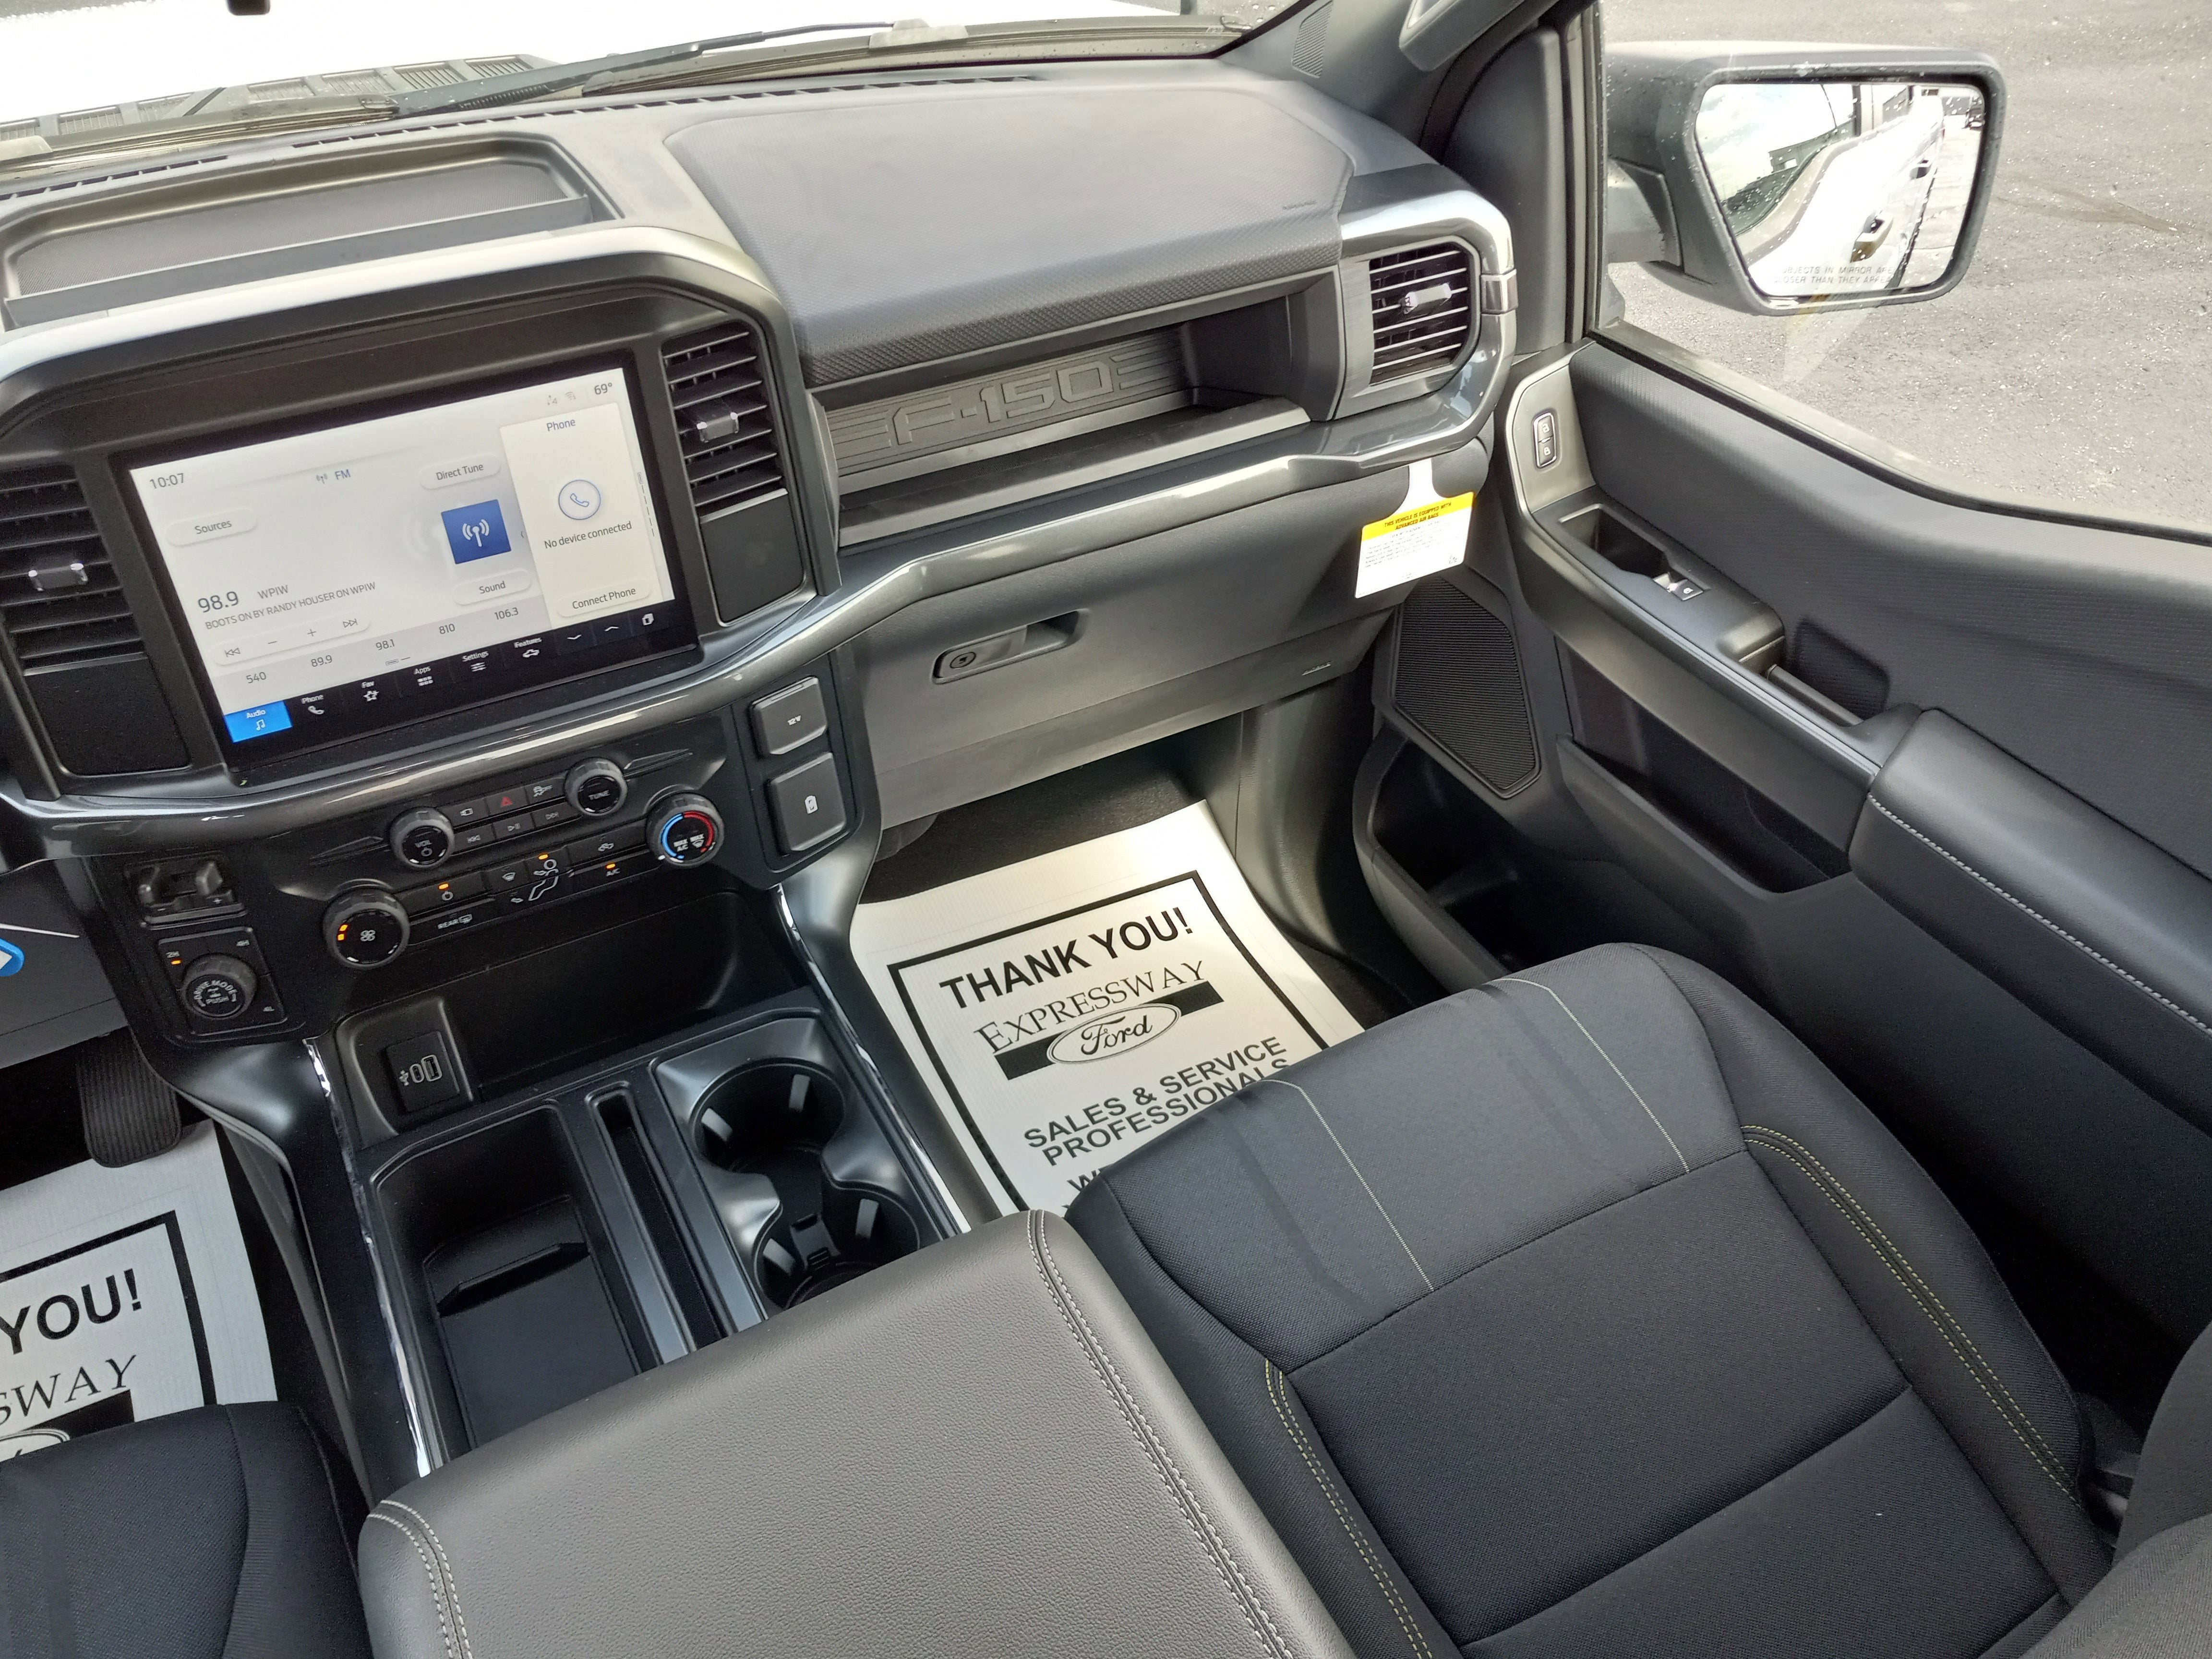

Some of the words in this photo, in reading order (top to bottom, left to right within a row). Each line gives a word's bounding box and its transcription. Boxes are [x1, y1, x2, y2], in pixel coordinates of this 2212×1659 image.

[594, 383, 613, 395] 69°
[892, 360, 1114, 445] F-150
[546, 418, 576, 432] Phone
[334, 469, 351, 480] FM
[435, 468, 461, 481] Direct
[462, 463, 484, 475] Tune
[149, 472, 185, 490] 10:07
[1395, 515, 1412, 524] VEHICLE
[1419, 506, 1439, 517] EQUIPPED
[194, 519, 232, 535] Sources
[1395, 519, 1418, 530] ADVANCED
[544, 538, 558, 549] No
[558, 531, 587, 545] device
[587, 521, 632, 540] connected
[257, 584, 289, 600] WPIW
[479, 581, 506, 594] Sound
[197, 591, 240, 613] 98.9
[572, 595, 608, 610] Connect
[608, 588, 636, 601] Phone
[204, 615, 237, 630] BOOTS
[238, 612, 253, 622] ON
[252, 609, 265, 618] BY
[266, 601, 297, 615] RANDY
[298, 591, 335, 607] HOUSER
[336, 589, 349, 598] ON
[349, 582, 376, 594] WPIW
[494, 607, 519, 620] 106.3
[439, 624, 455, 634] 810
[375, 639, 395, 650] 98.1
[514, 637, 542, 648] Features
[311, 655, 333, 667] 89.9
[462, 651, 489, 662] Settings
[414, 666, 431, 674] Apps
[246, 672, 267, 684] 540
[361, 681, 374, 689] Fav
[301, 694, 325, 704] Phone
[246, 709, 266, 719] Audio
[788, 715, 801, 725] 12V
[588, 790, 611, 801] TUNE
[414, 840, 433, 848] VOL
[606, 868, 620, 877] A/C
[437, 918, 459, 929] REAR
[939, 939, 1092, 1009] THANK
[1088, 907, 1193, 960] YOU!
[974, 960, 1205, 1054] EXPRESSWAY
[1080, 1014, 1153, 1055] Ford
[1023, 1097, 1127, 1148] SALES
[1132, 1086, 1157, 1106] &
[1159, 1036, 1287, 1094] SERVICE
[0, 1268, 142, 1355] YOU!
